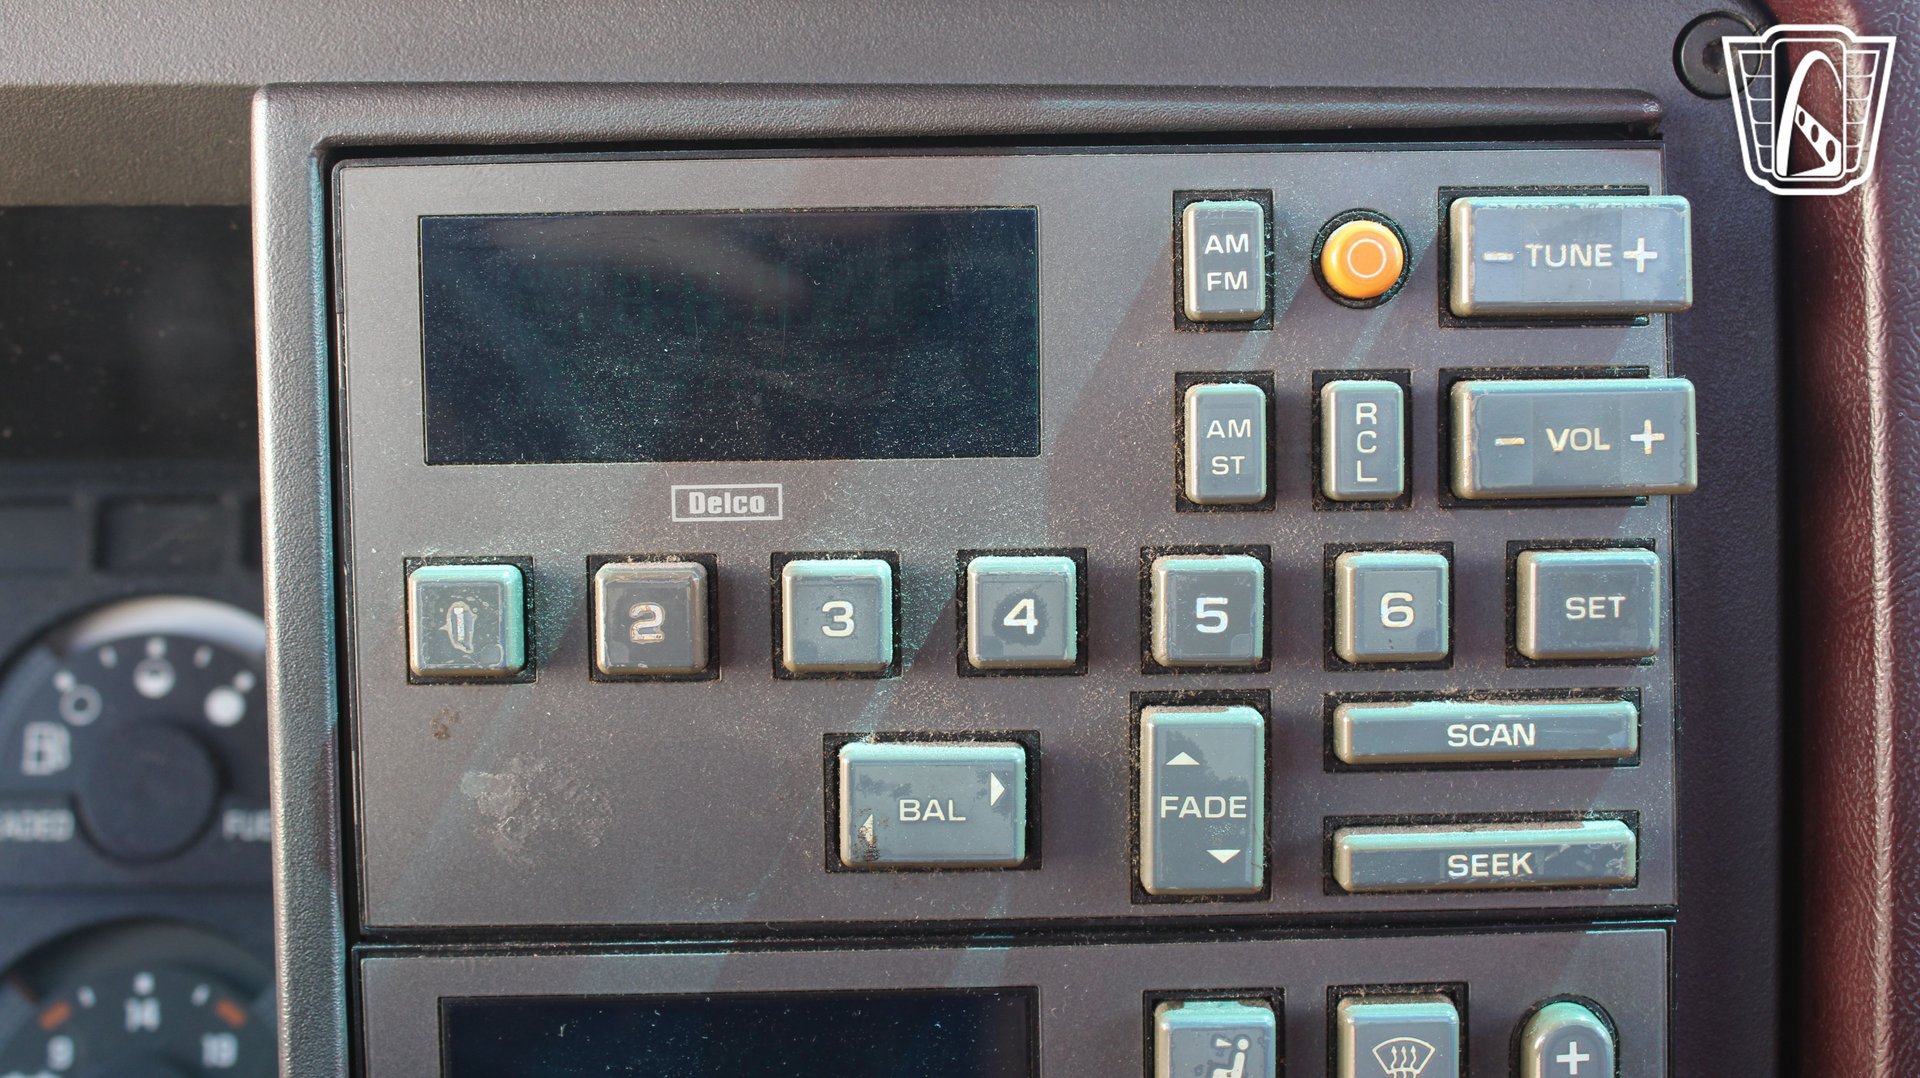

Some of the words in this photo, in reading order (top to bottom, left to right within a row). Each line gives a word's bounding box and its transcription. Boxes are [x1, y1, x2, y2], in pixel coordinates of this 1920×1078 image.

[1204, 233, 1249, 255] AM
[1524, 243, 1613, 268] TUNE
[1206, 270, 1248, 292] FM
[1206, 418, 1251, 439] AM
[1545, 427, 1611, 452] VOL
[1211, 455, 1246, 475] ST
[688, 489, 766, 516] Delco
[821, 599, 856, 637] 3
[1002, 597, 1040, 636] 4
[1194, 596, 1229, 634] 5
[1379, 591, 1415, 628] 6
[1565, 596, 1626, 620] SET
[629, 603, 664, 642] 2
[1446, 723, 1536, 748] SCAN
[898, 798, 967, 822] BAL
[1160, 795, 1248, 819] FADE
[223, 809, 271, 842] FUE
[1447, 852, 1533, 878] SEEK
